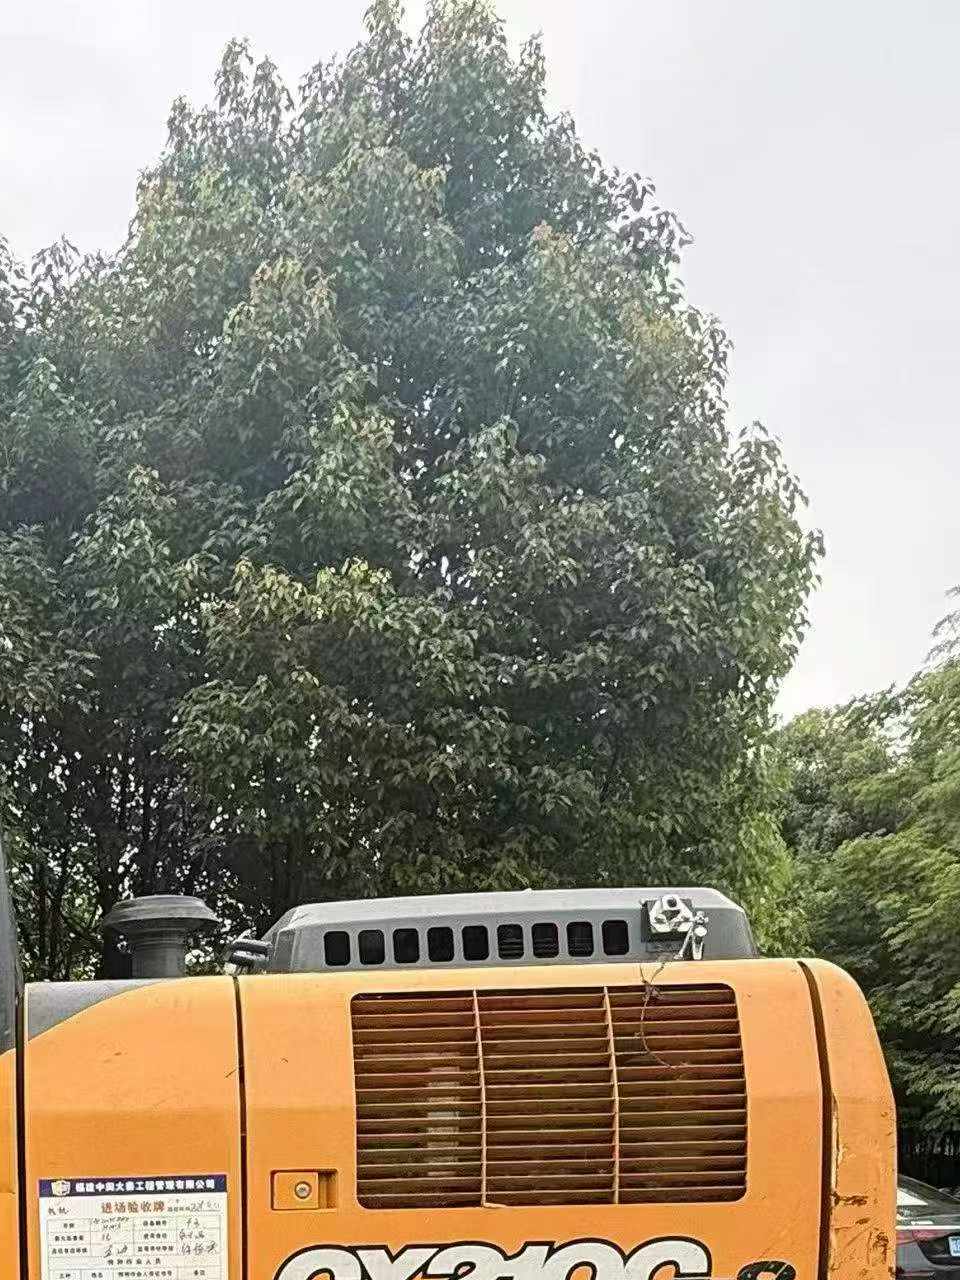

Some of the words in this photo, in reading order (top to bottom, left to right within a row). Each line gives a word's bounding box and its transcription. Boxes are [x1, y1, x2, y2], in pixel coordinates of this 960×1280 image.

[101, 1201, 165, 1214] 进场验收牌
